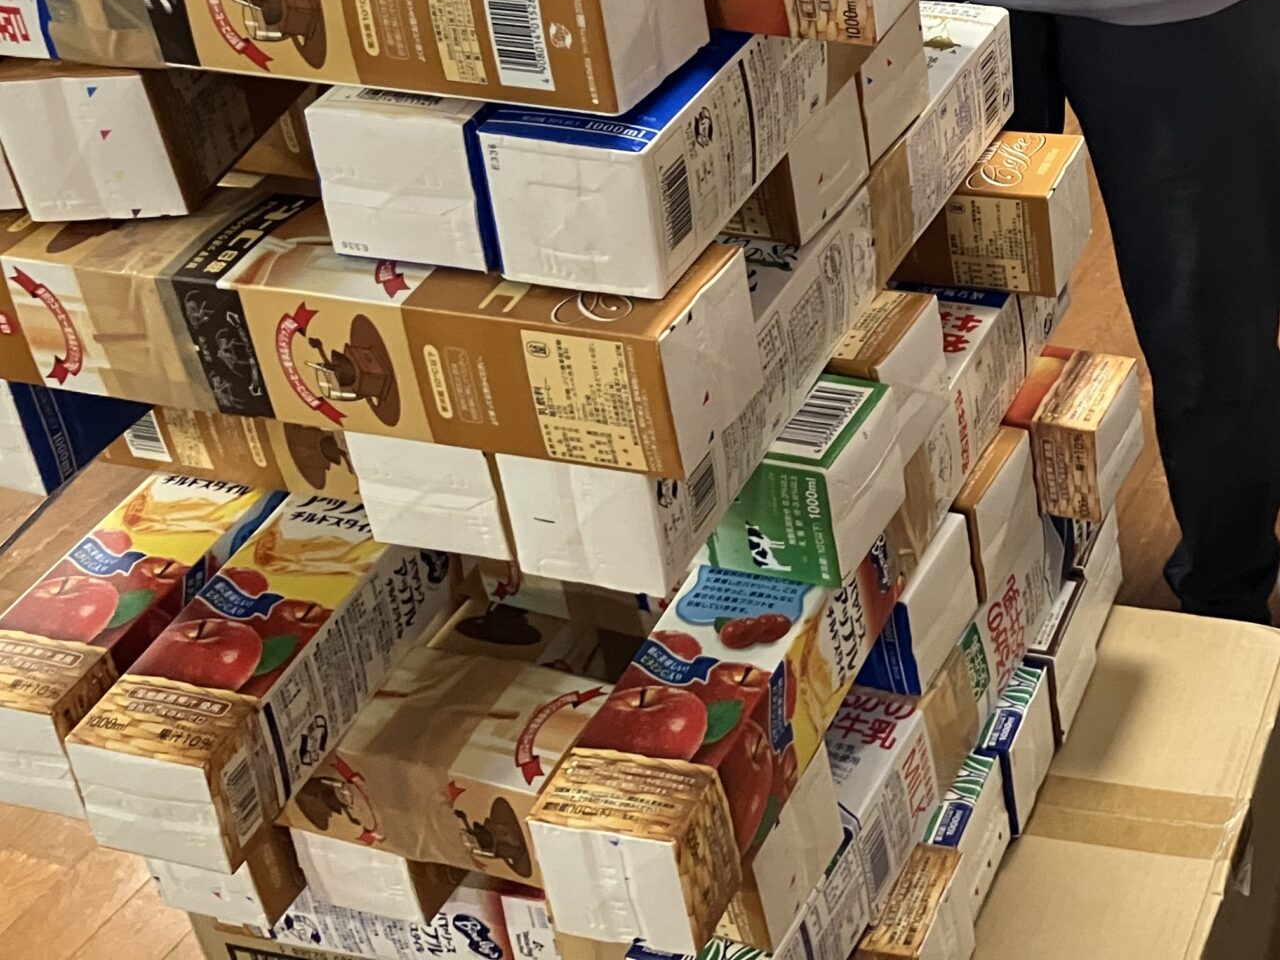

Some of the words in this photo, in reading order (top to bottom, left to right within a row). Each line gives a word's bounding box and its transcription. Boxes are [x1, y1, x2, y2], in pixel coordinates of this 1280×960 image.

[585, 120, 648, 139] 1000ml
[965, 133, 1047, 191] Coffee
[202, 199, 307, 274] 毎日コーヒー
[162, 474, 251, 499] チルドスタイル
[807, 476, 827, 521] 1000ml
[833, 591, 858, 673] アップル
[157, 728, 215, 751] 果汁10%
[901, 749, 927, 819] MILK
